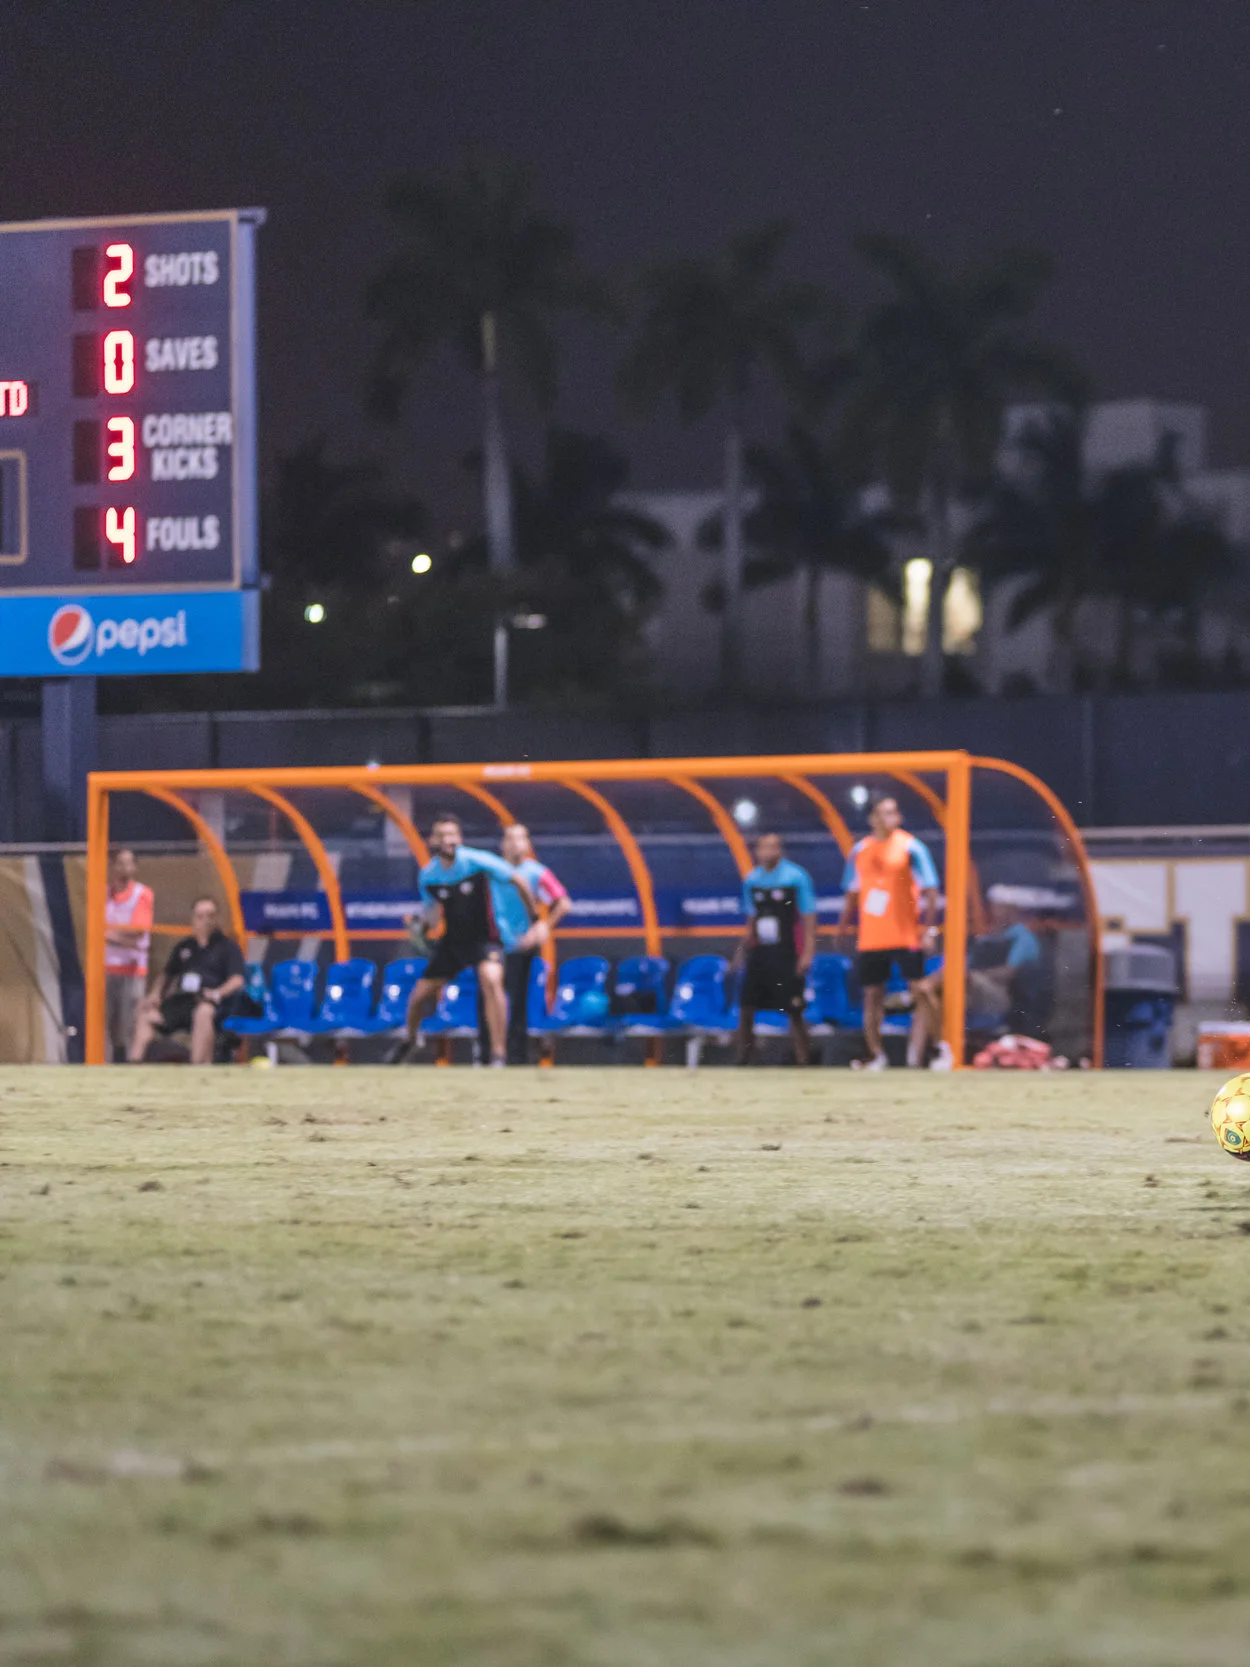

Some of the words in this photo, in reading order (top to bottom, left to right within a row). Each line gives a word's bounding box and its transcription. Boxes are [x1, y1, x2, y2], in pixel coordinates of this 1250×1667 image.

[104, 243, 133, 307] 2
[144, 250, 218, 288] SHOTS
[104, 330, 134, 394] 0
[145, 335, 218, 373] SAVES
[107, 416, 135, 481] 3
[142, 411, 232, 448] CORNER
[151, 446, 218, 481] KICKS
[106, 506, 135, 564] 4
[146, 514, 220, 551] FOULS
[96, 609, 187, 657] pepsi
